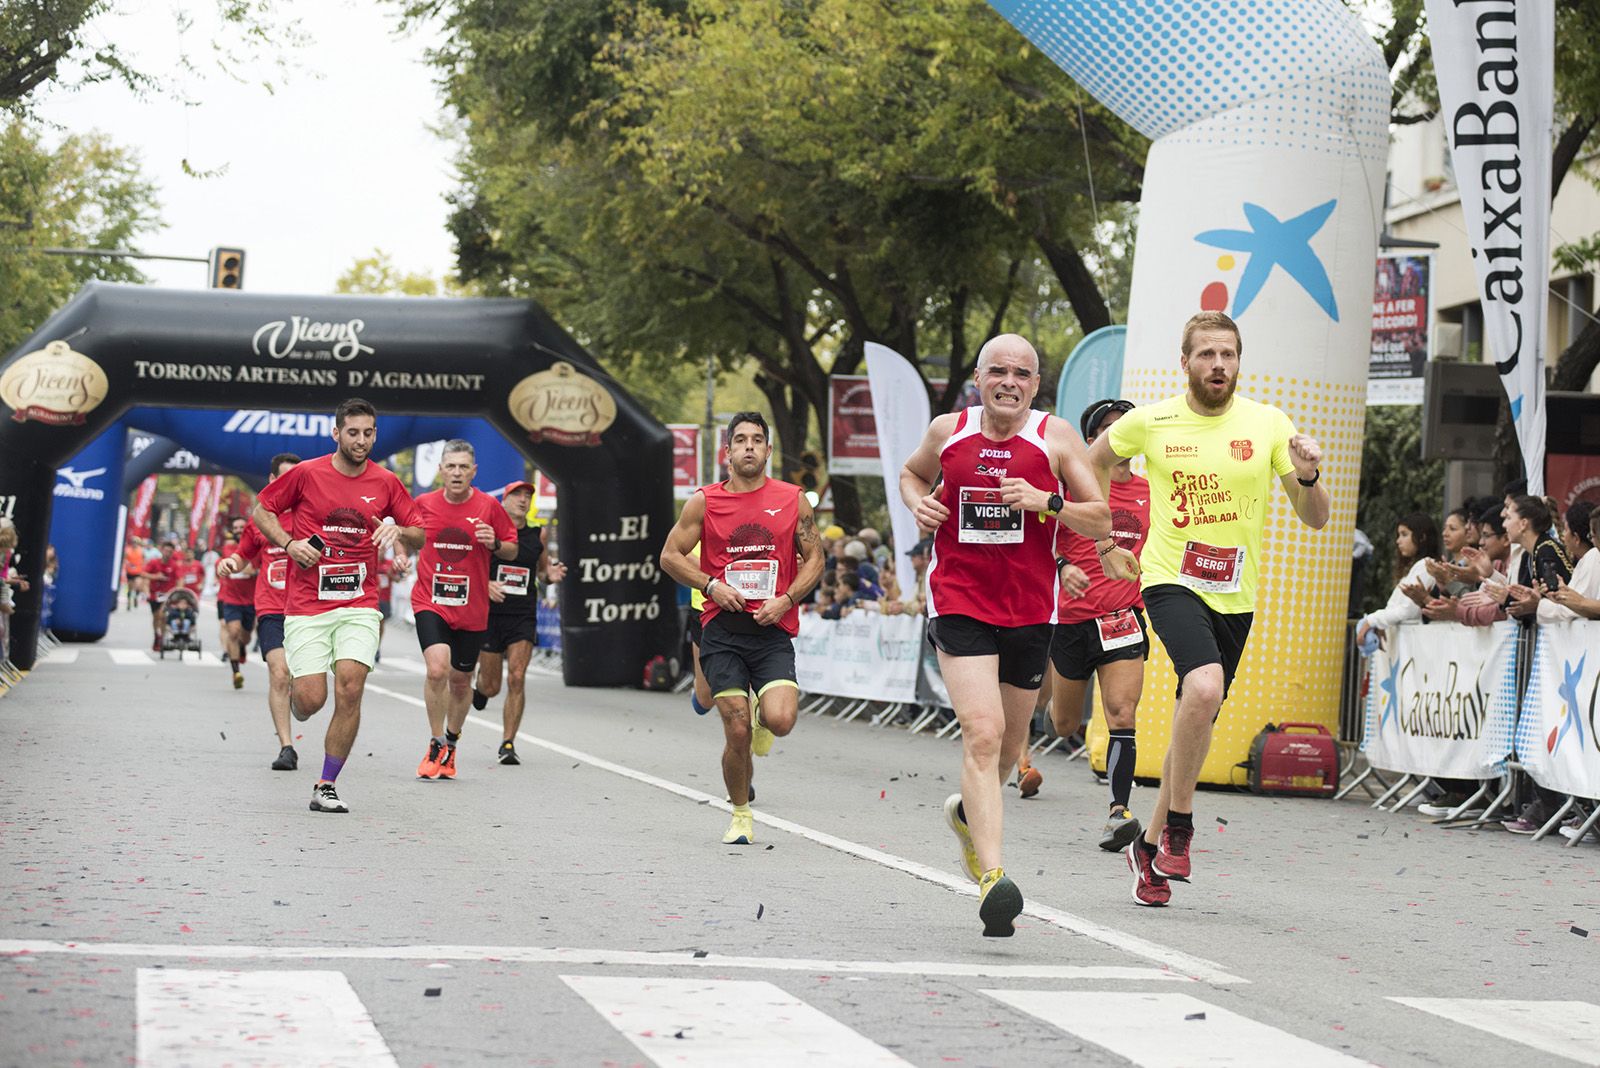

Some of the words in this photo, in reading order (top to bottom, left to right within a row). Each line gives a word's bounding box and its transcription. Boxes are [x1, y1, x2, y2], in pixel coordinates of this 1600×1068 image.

[1452, 0, 1525, 376] CaixaBan
[134, 360, 233, 382] TORRONS
[235, 364, 338, 386] ARTESANS
[349, 369, 486, 391] D'AGRAMUNT
[222, 409, 337, 437] MIZUN
[1171, 470, 1220, 493] CROS
[974, 505, 1010, 518] VICEN
[1170, 489, 1190, 529] 3
[1187, 490, 1233, 508] TURONS
[1192, 506, 1206, 516] LA
[1193, 512, 1239, 526] DIABLADA
[578, 554, 661, 584] Torró,
[1195, 556, 1228, 571] SERGI
[329, 576, 355, 584] VICTOR
[739, 573, 761, 581] ALEX
[443, 584, 459, 592] PAU
[584, 595, 661, 623] Torró
